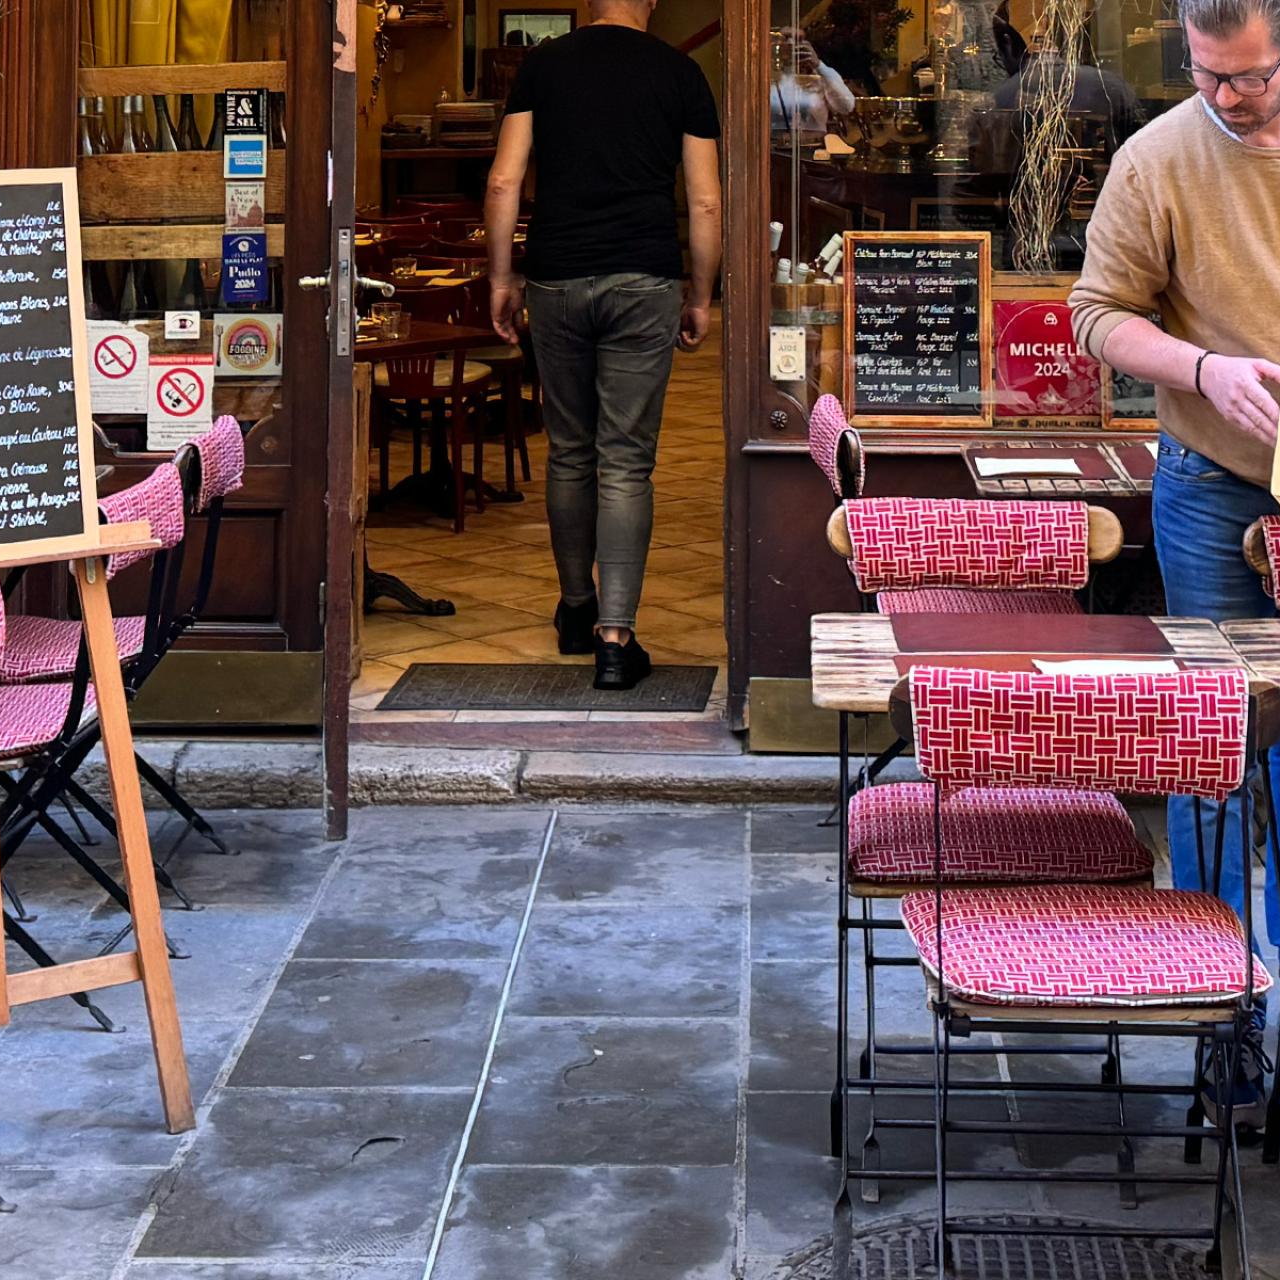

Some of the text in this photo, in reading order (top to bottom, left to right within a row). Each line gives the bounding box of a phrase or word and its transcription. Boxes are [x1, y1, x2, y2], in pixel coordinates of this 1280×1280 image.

[237, 97, 253, 116] &
[236, 117, 257, 127] SEL
[1009, 342, 1082, 357] MICHELI
[1034, 362, 1069, 377] 2024
